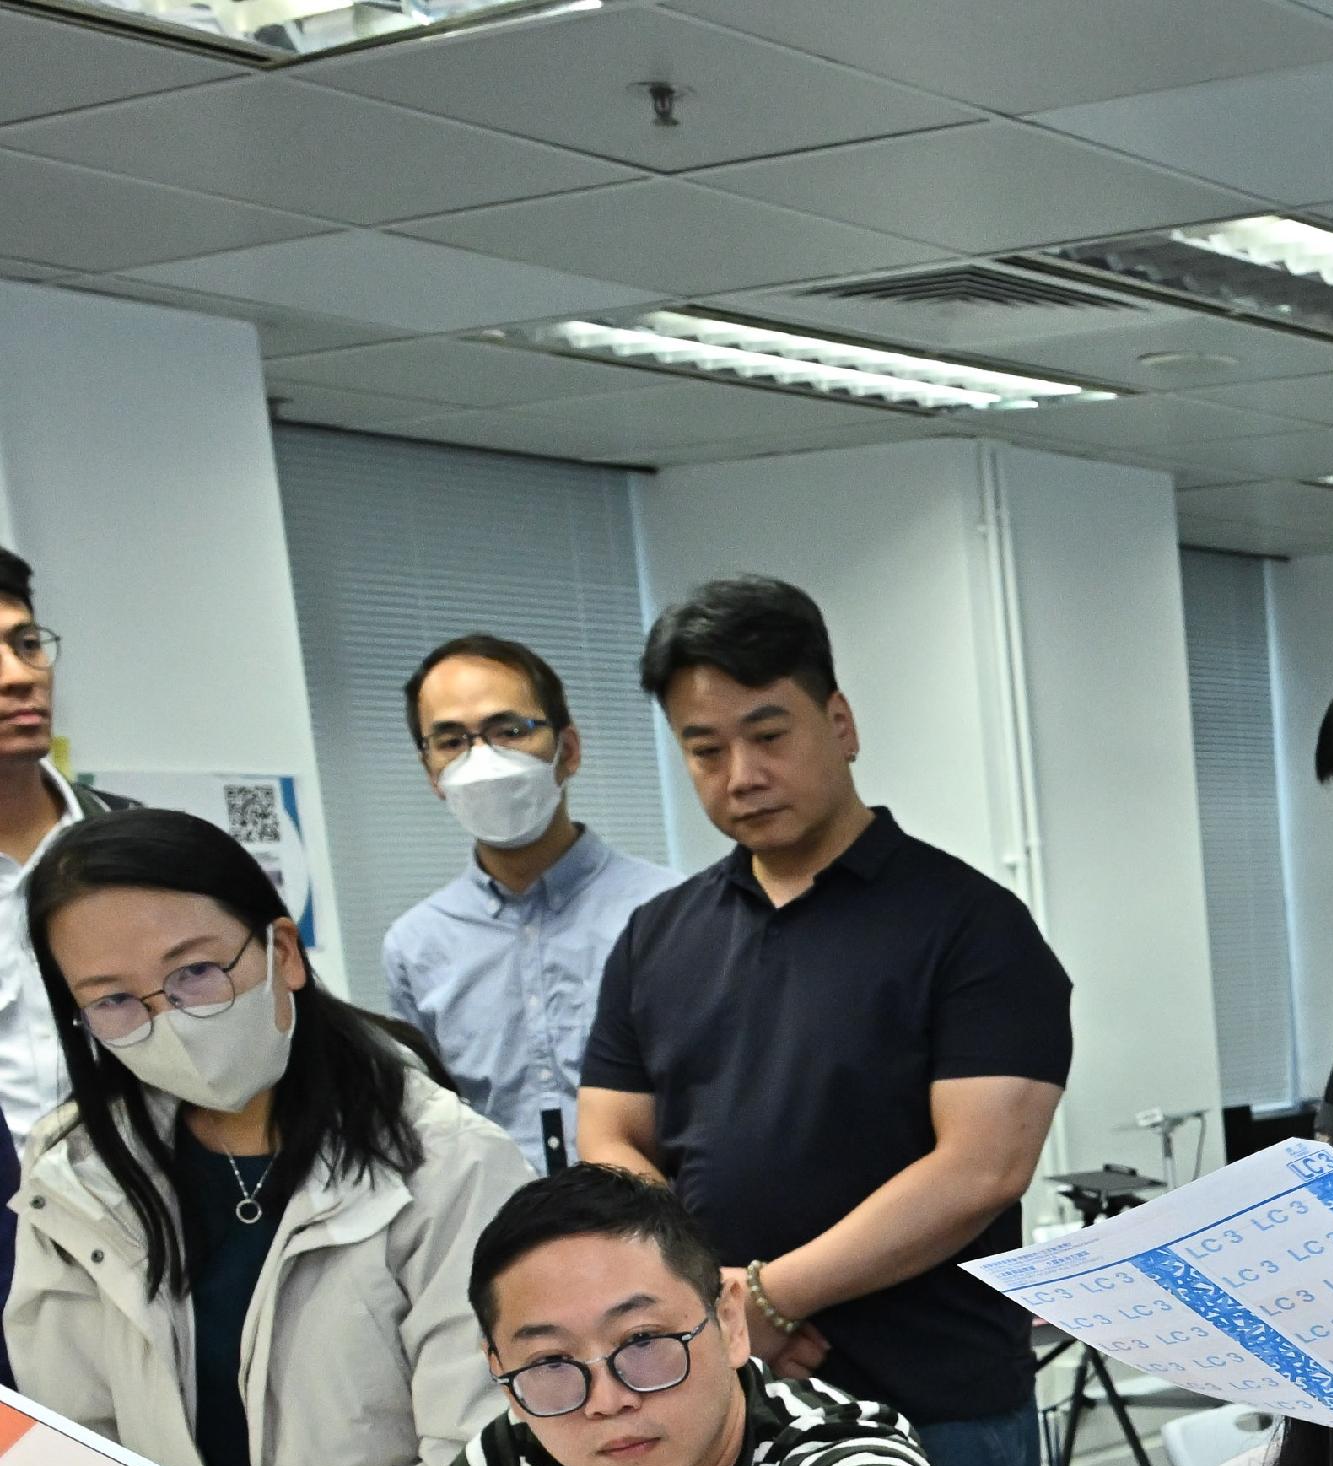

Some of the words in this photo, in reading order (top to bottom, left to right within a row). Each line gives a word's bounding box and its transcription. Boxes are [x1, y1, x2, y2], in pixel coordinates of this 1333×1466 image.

[1291, 1158, 1322, 1180] LC
[1252, 1209, 1289, 1232] LC
[1291, 1200, 1308, 1215] 3
[1186, 1238, 1223, 1259] LC
[1224, 1229, 1242, 1244] 3
[1287, 1241, 1324, 1262] LC
[1084, 1277, 1115, 1294] LC
[1118, 1272, 1133, 1284] 3
[1223, 1268, 1260, 1289] LC
[1260, 1260, 1279, 1274] 3
[1120, 1306, 1152, 1320] LC
[1153, 1301, 1172, 1313] 3
[1260, 1296, 1296, 1316] LC
[1296, 1290, 1314, 1302] 3
[1295, 1324, 1330, 1344] LC
